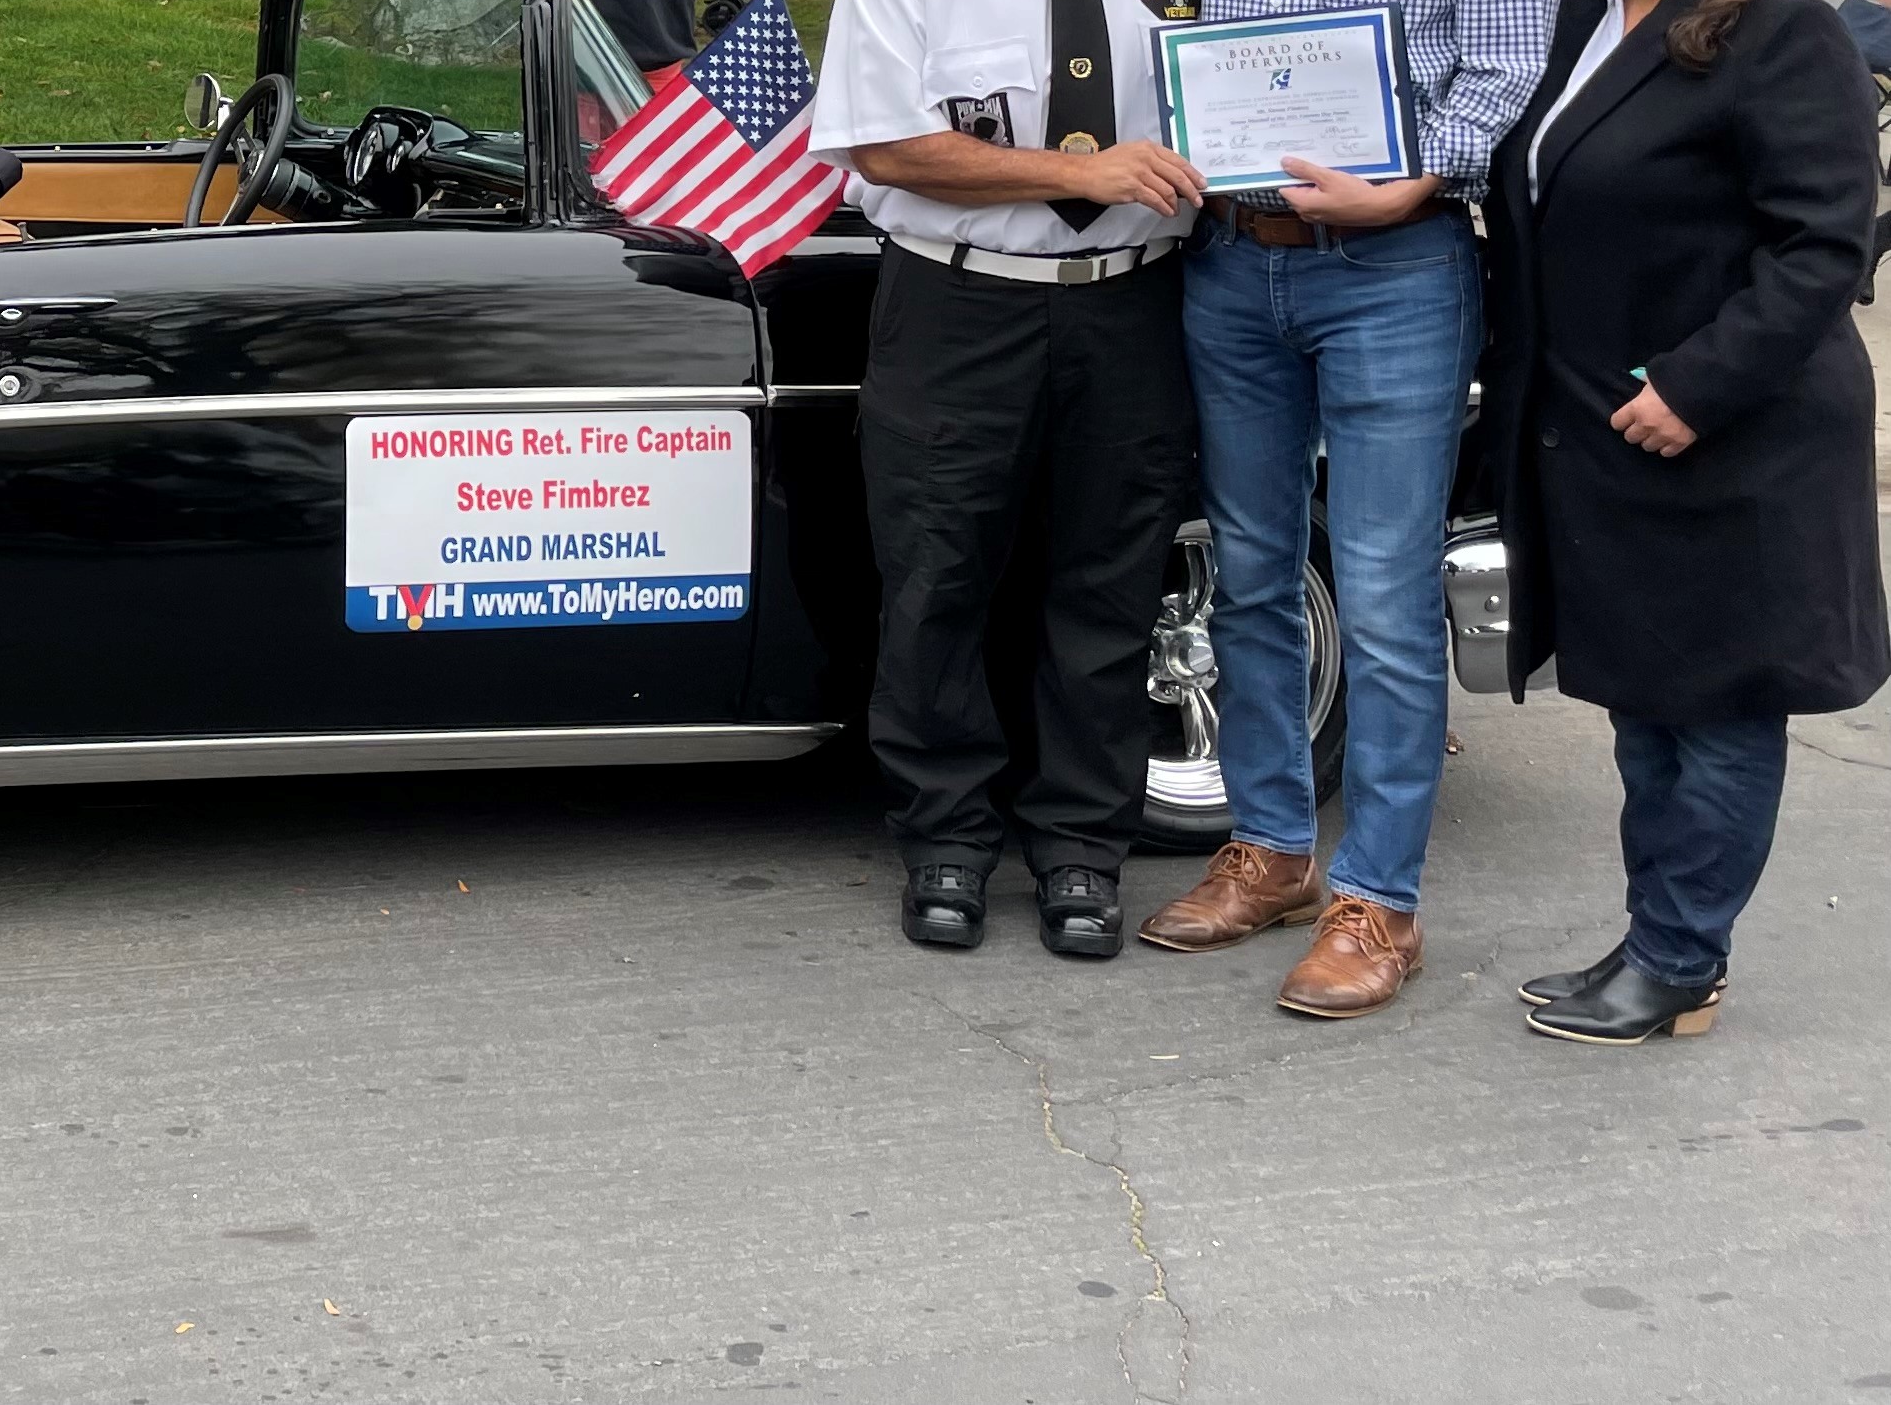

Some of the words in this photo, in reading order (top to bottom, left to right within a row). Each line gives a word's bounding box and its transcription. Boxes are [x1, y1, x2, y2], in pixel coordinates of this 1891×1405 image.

[1215, 51, 1342, 73] SUPERVISORS
[1229, 44, 1291, 60] BOARD
[1302, 40, 1325, 53] OF
[371, 429, 514, 460] HONORING
[522, 428, 571, 455] Ret.
[580, 426, 628, 454] Fire
[636, 425, 733, 458] Captain
[457, 481, 533, 512] Steve
[542, 479, 650, 509] Fimbrez
[441, 536, 532, 564] GRAND
[541, 531, 666, 561] MARSHAL
[472, 581, 744, 621] www.ToMyHero.com
